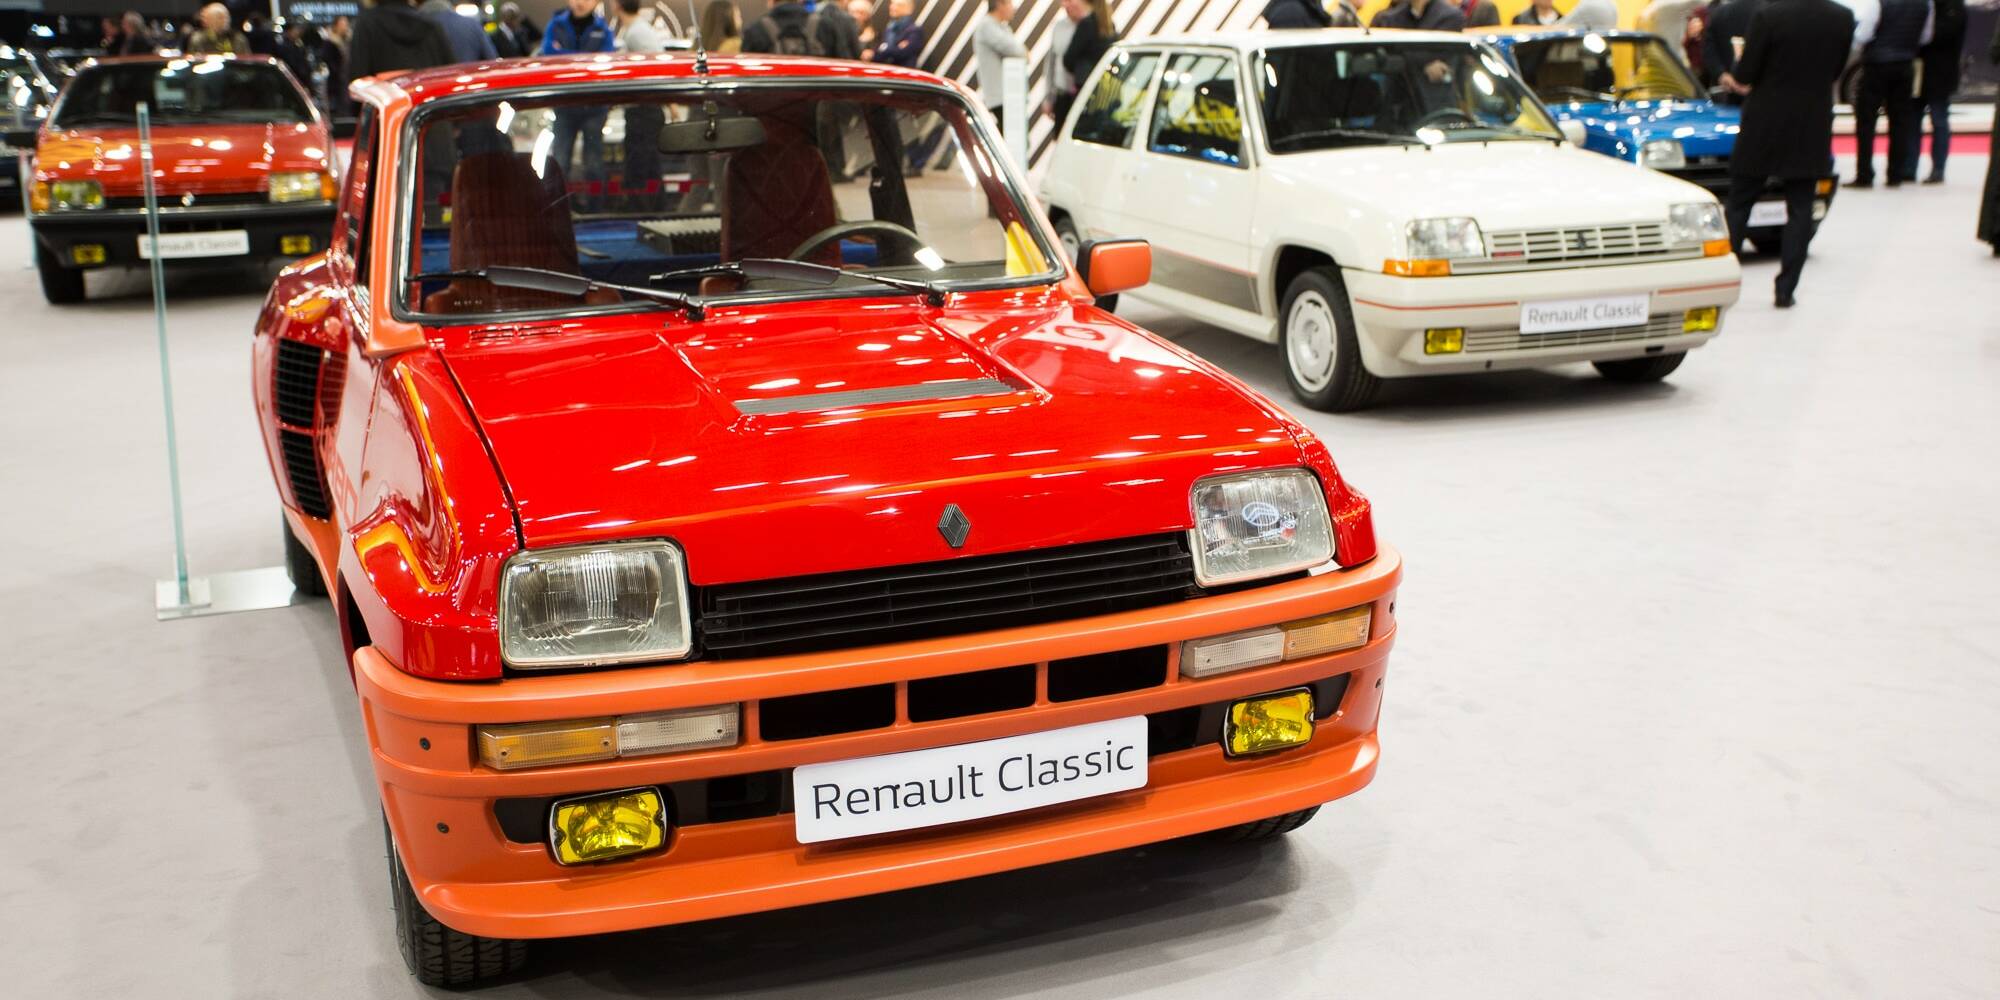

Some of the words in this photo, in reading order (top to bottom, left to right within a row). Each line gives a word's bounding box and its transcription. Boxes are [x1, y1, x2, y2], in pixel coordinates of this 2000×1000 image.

[1527, 304, 1589, 325] Renault
[1593, 301, 1644, 321] Classic
[812, 764, 985, 820] Renault
[998, 740, 1135, 793] Classic
